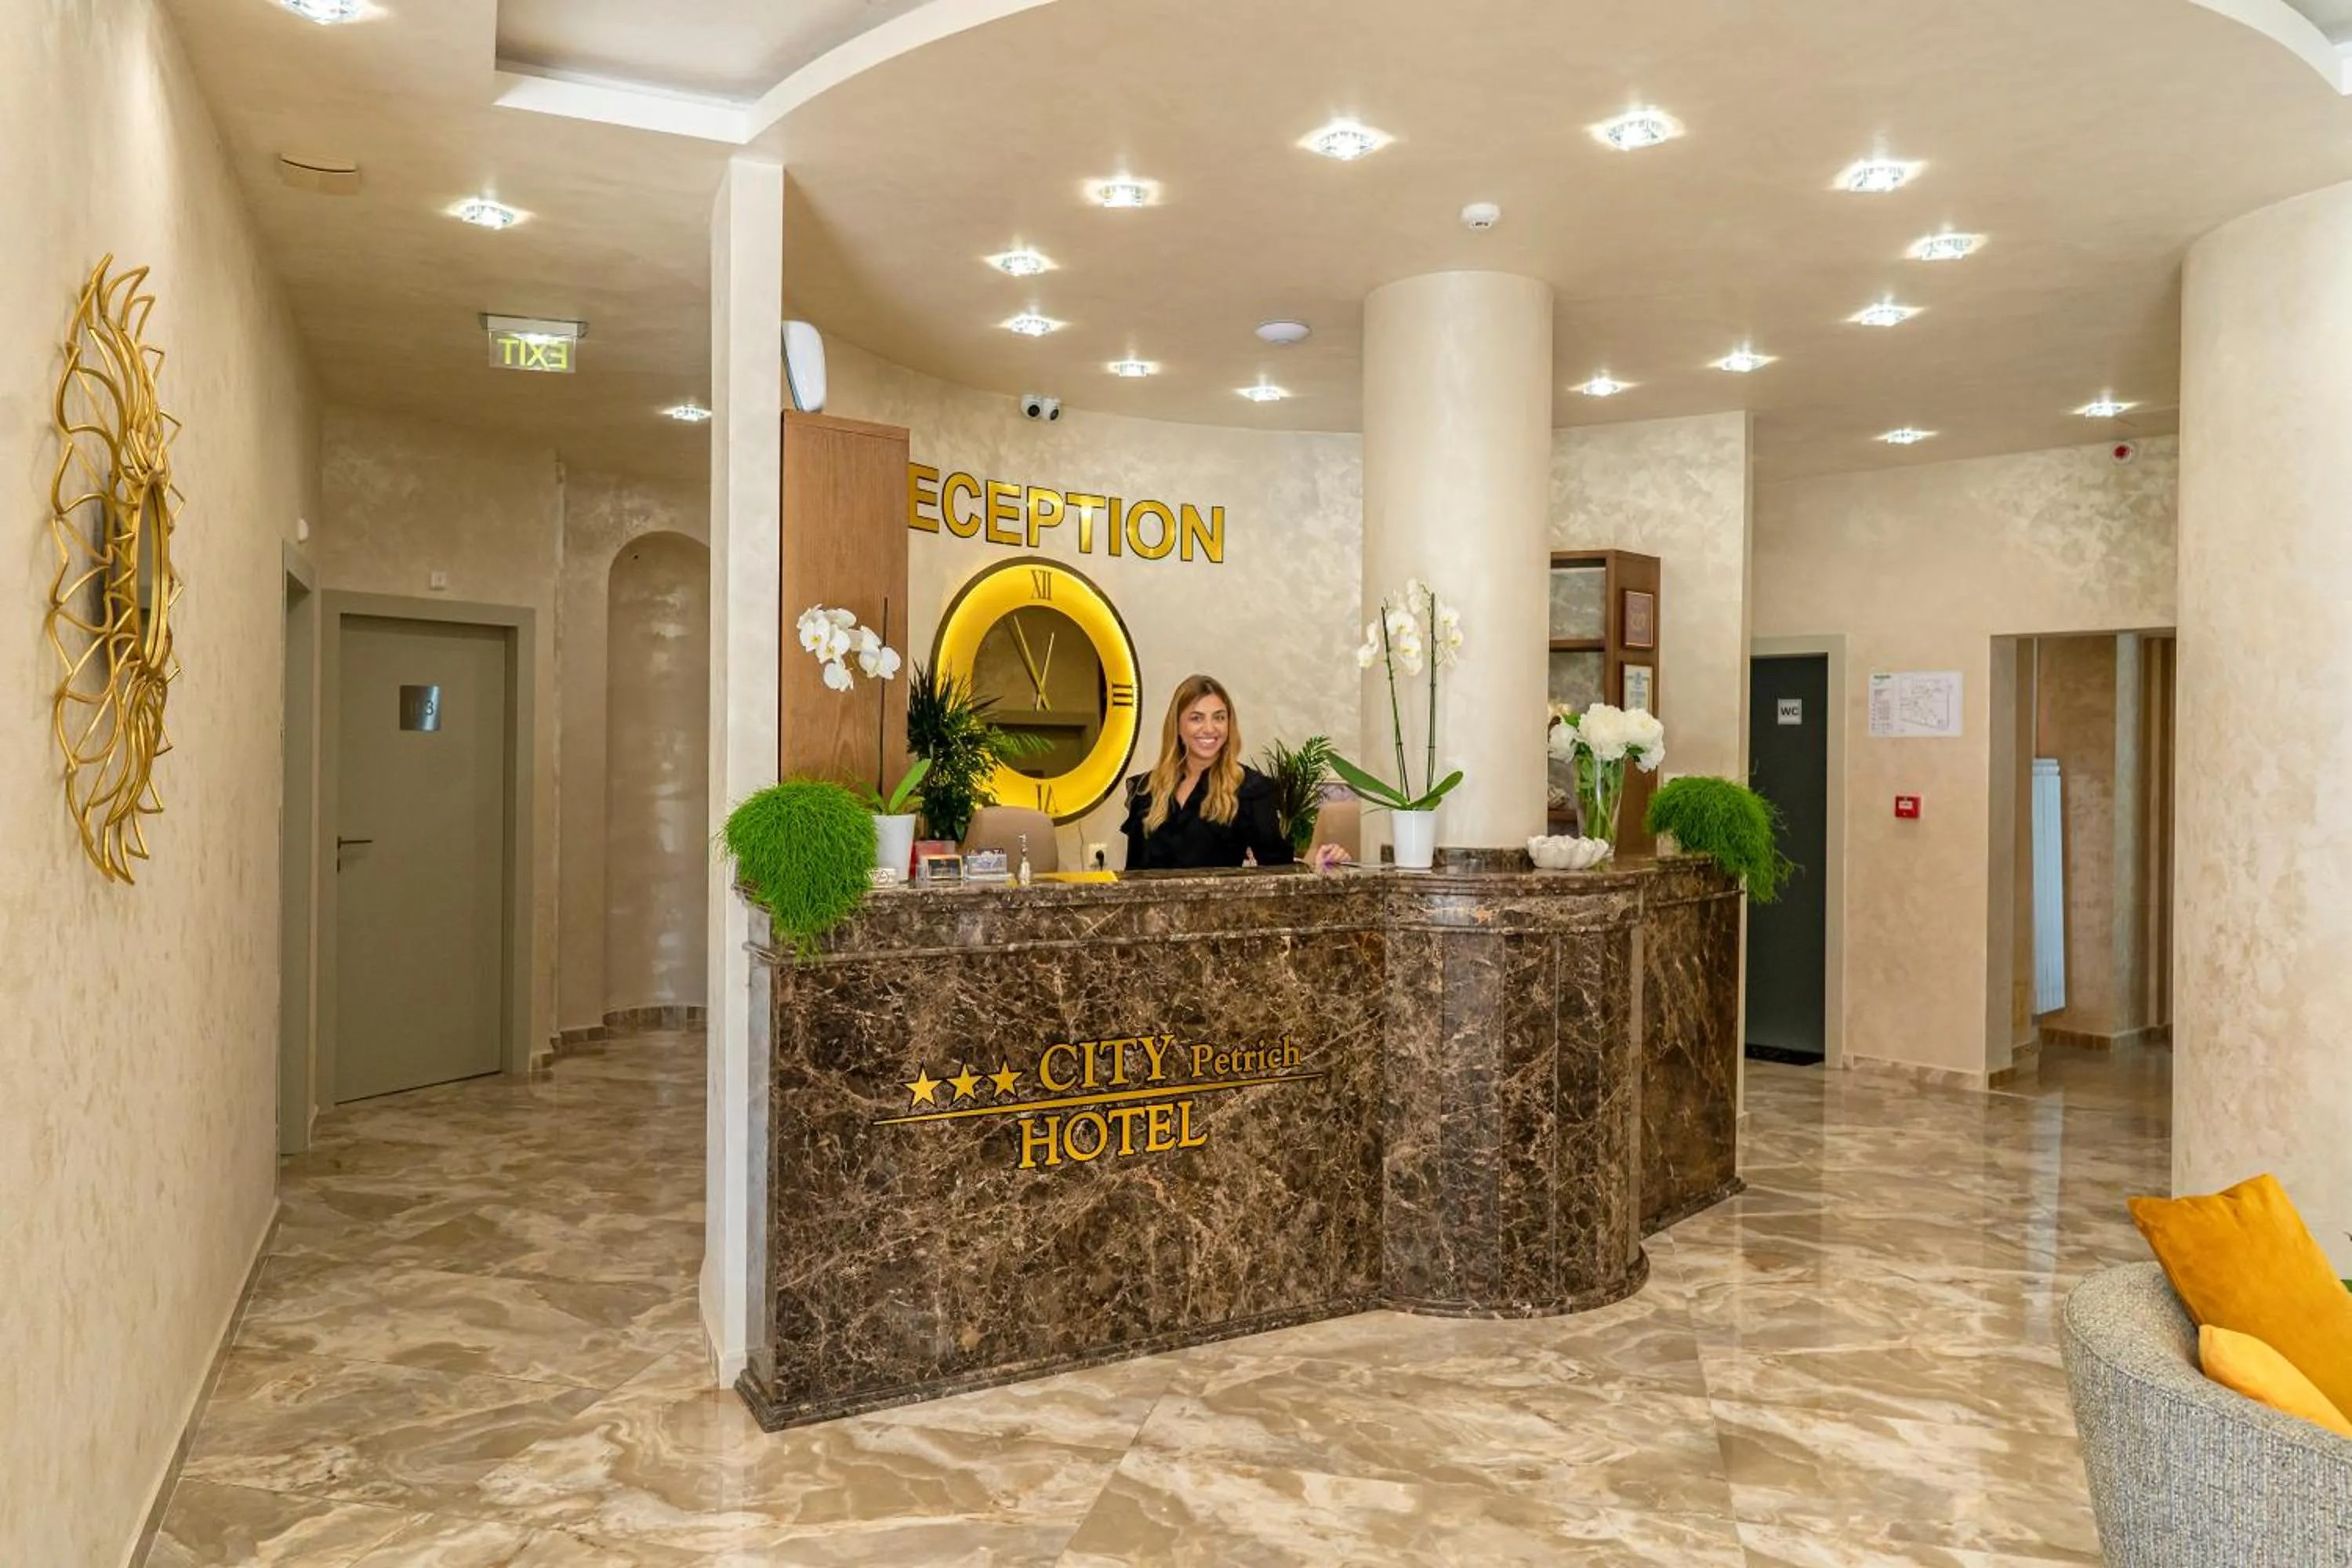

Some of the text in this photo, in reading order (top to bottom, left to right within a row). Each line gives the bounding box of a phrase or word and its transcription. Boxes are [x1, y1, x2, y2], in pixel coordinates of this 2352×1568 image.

[908, 463, 1225, 563] ECEPTION
[1030, 569, 1052, 601] XII
[1780, 706, 1800, 716] WC
[1039, 1034, 1303, 1092] CITY Petrich
[1018, 1100, 1208, 1169] HOTEL
